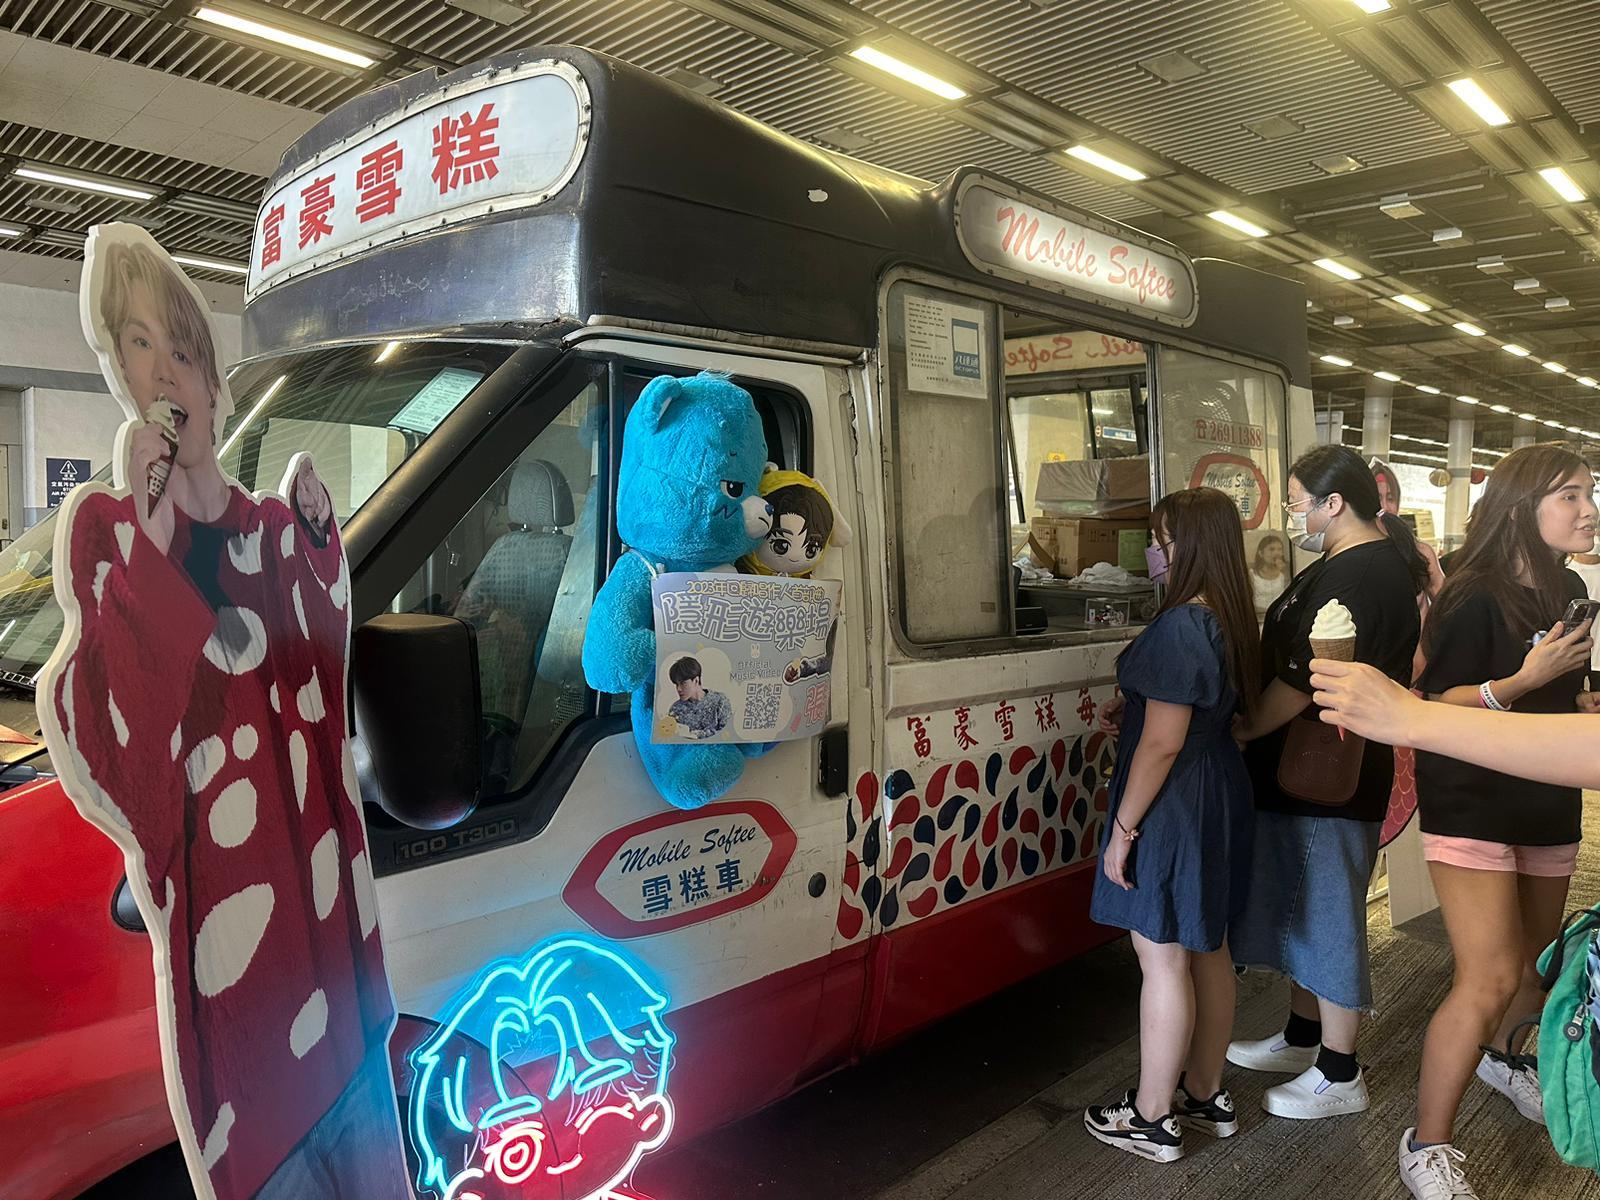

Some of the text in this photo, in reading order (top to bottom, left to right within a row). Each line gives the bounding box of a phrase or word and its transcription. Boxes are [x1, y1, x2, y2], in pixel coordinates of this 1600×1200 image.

[261, 103, 499, 270] 富豪雪糕
[997, 207, 1176, 304] Mobile Softee
[660, 592, 832, 651] 隱形遊樂場
[907, 685, 1121, 758] 富豪雪糕每
[401, 820, 515, 859] 100 T300
[619, 826, 756, 874] Mobile Softee
[641, 858, 743, 913] 雪糕車
